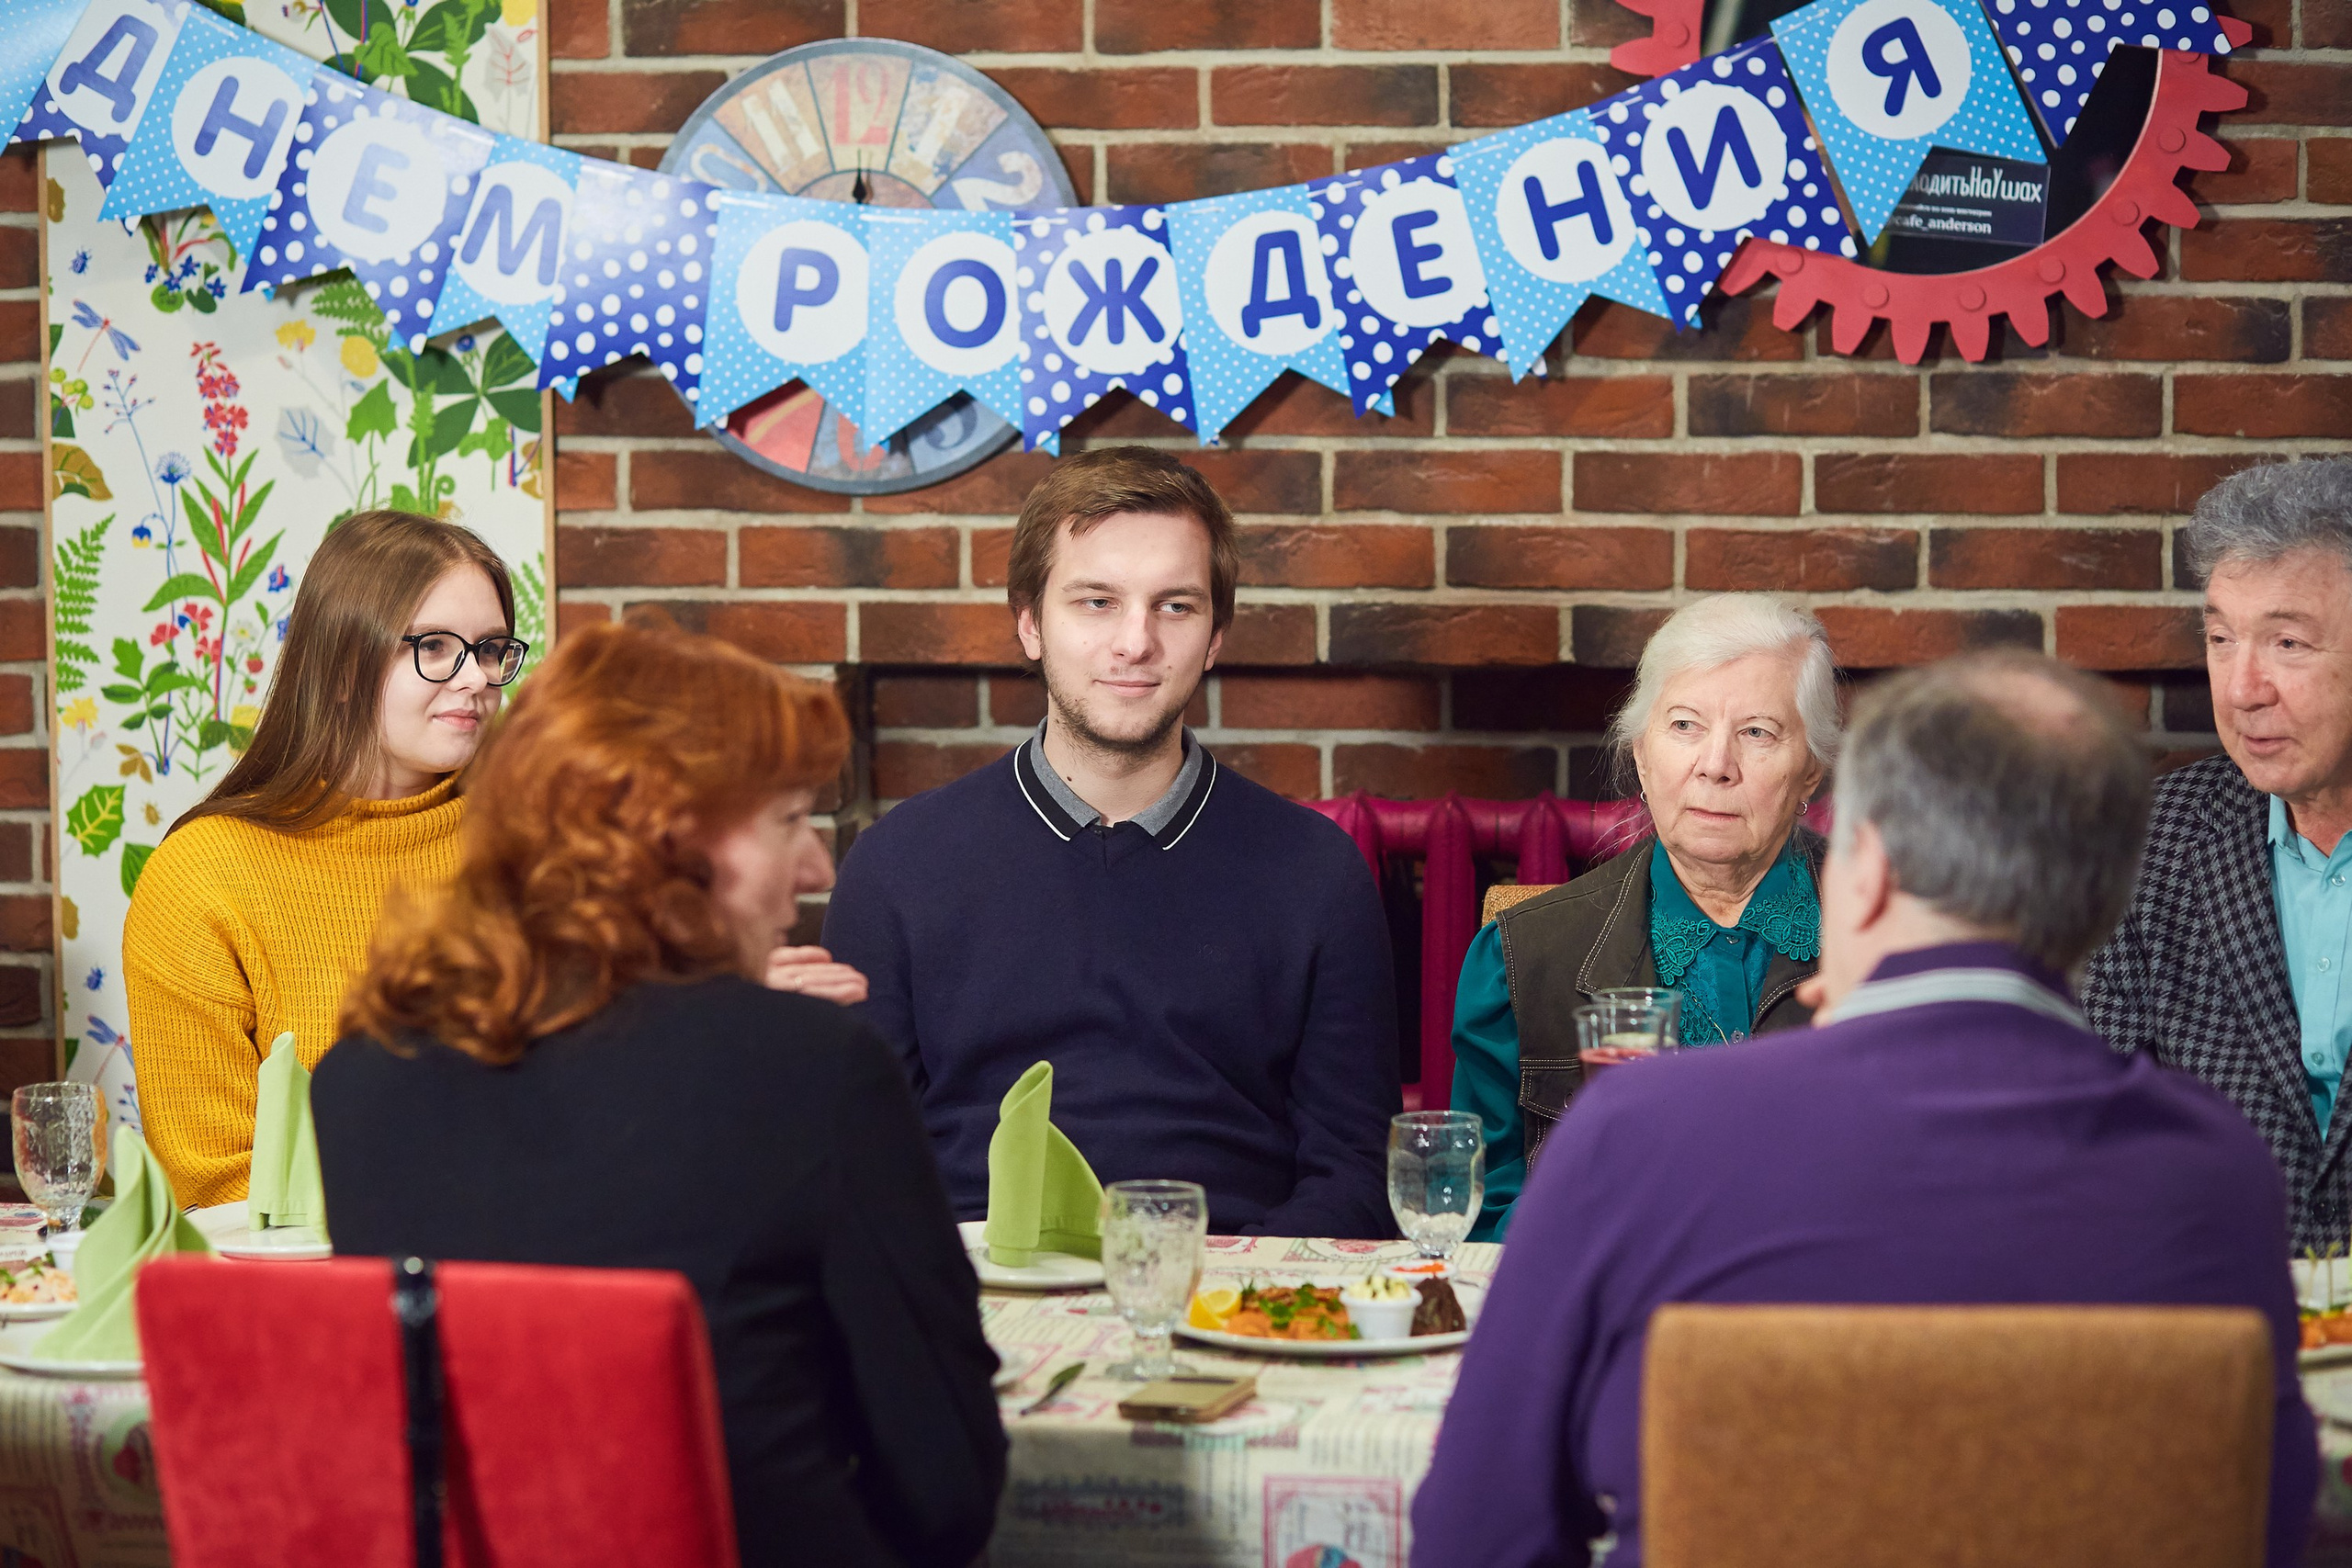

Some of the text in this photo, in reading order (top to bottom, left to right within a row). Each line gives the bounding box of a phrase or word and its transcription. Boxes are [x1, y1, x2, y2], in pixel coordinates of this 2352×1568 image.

[58, 13, 1942, 348] ДНЕМ РОЖДЕНИЯ
[831, 62, 890, 146] 12
